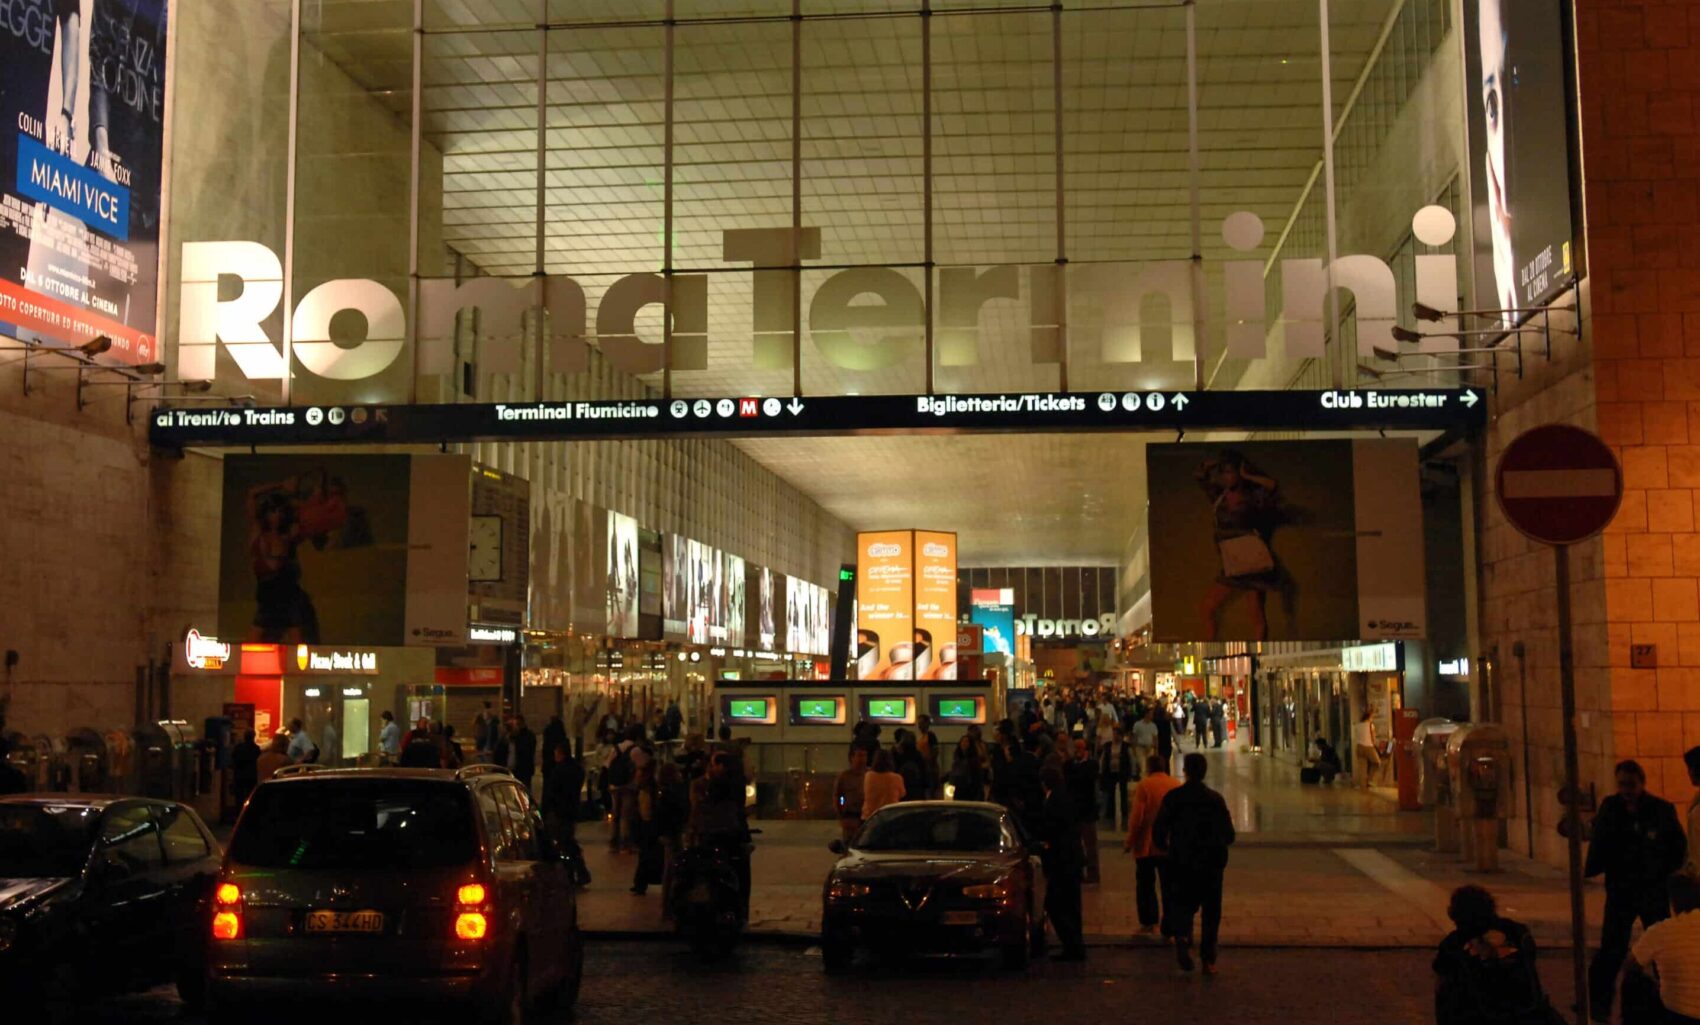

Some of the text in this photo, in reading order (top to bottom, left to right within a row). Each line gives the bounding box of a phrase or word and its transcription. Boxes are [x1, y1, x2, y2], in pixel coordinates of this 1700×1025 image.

[18, 112, 43, 139] COLIN
[113, 163, 132, 186] FOXX
[31, 158, 81, 205] MIAMI
[84, 182, 118, 224] VICE
[45, 279, 79, 301] OTTOBRE
[81, 291, 90, 304] AL
[92, 295, 118, 317] CINEMA
[19, 300, 60, 326] COPERTURA
[917, 394, 1086, 416] Biglietteria/Tickets
[1321, 390, 1448, 410] Club Eurostar
[157, 409, 295, 427] ai Treni/to Trains
[496, 404, 571, 421] Terminal
[576, 403, 659, 420] Fiumicino
[308, 913, 327, 930] CS
